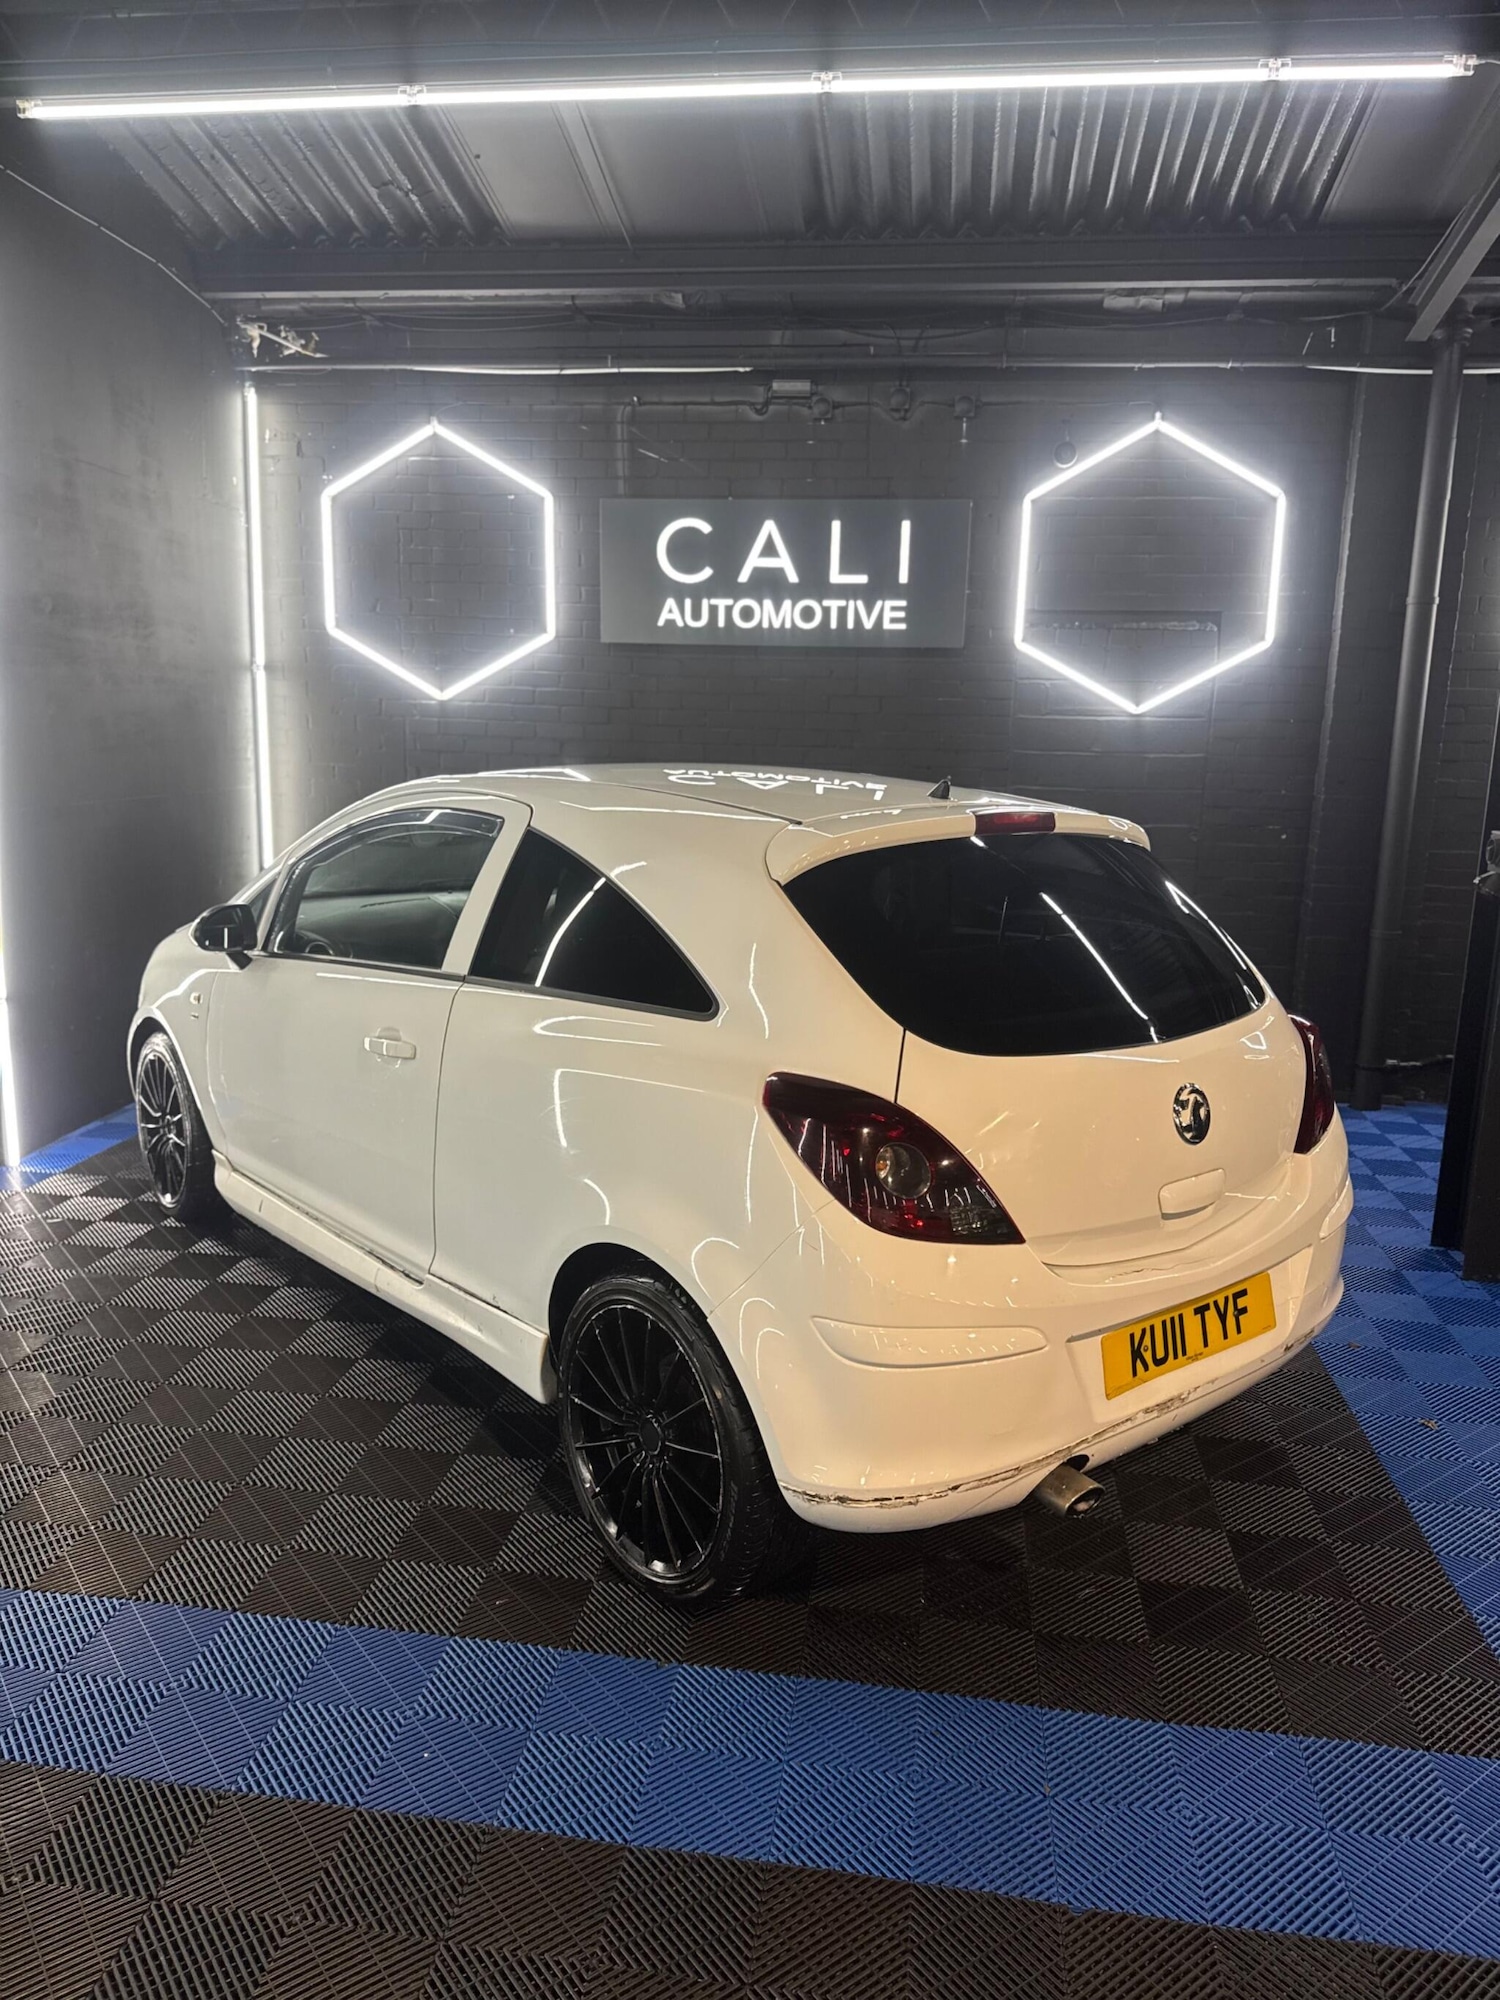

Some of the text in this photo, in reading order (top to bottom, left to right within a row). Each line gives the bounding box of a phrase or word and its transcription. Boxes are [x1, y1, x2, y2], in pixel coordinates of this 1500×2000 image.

[656, 517, 911, 584] CALI
[657, 597, 908, 630] AUTOMOTIVE
[1129, 1288, 1248, 1378] KU11 TYF
